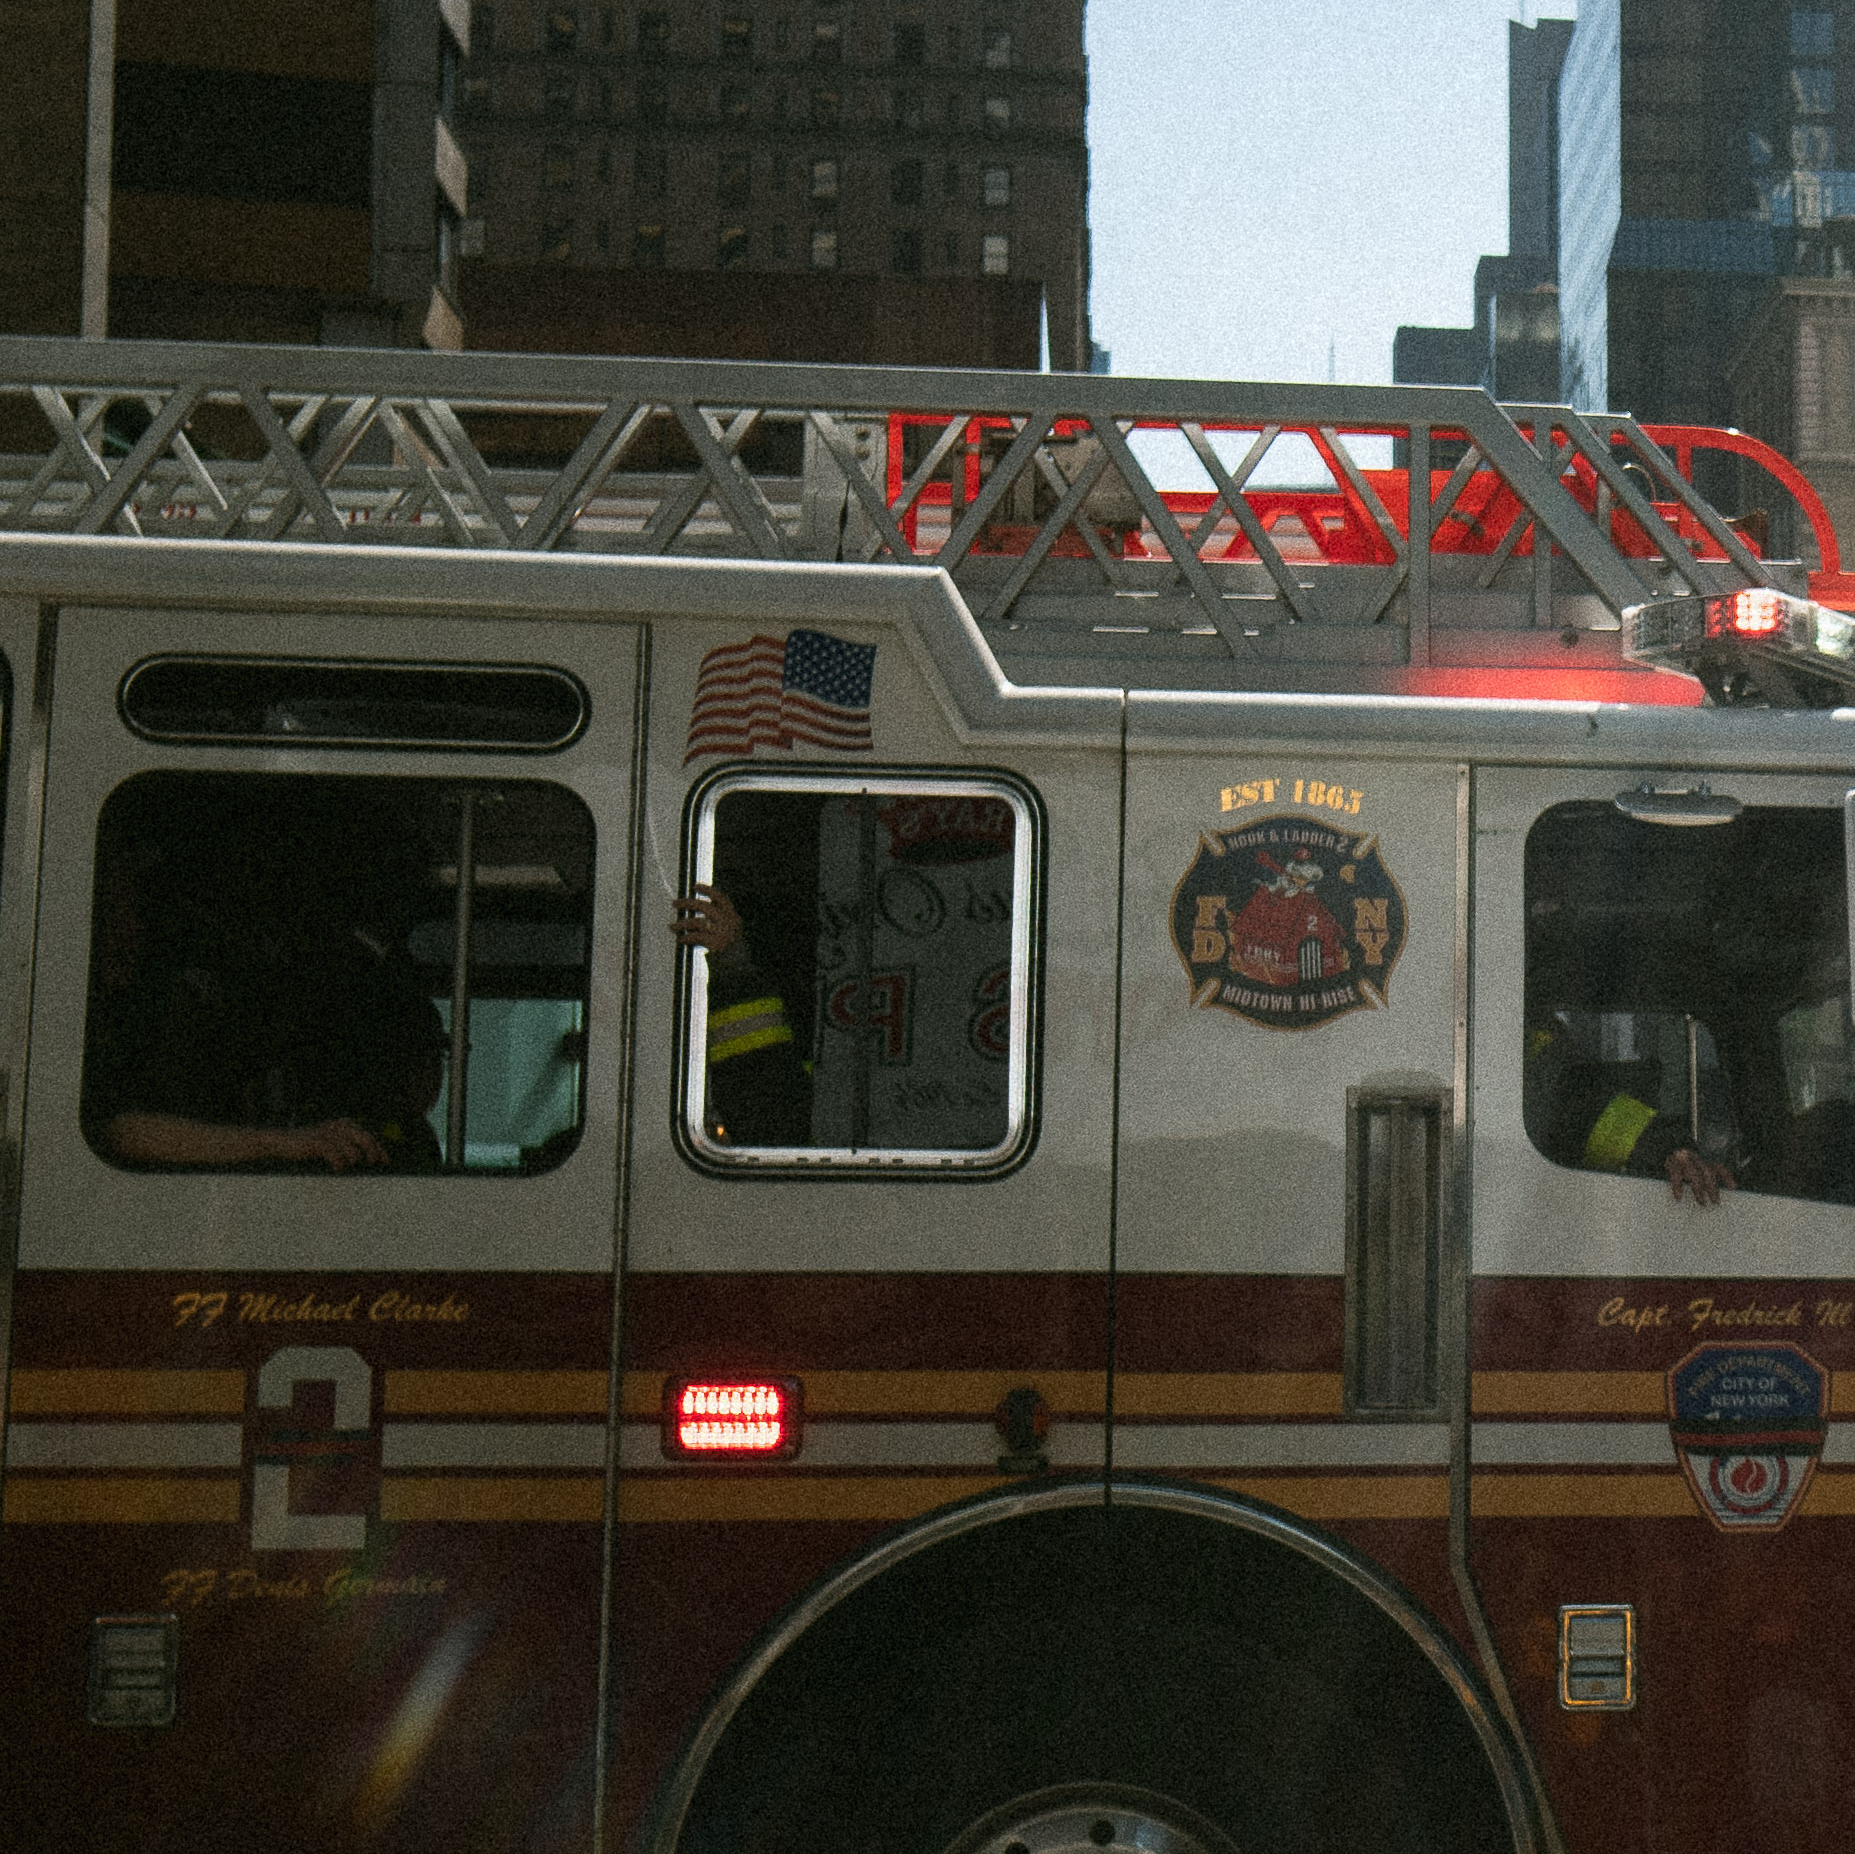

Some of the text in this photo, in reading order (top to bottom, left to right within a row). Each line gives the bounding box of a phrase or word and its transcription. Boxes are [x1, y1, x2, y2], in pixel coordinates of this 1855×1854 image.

[1219, 777, 1364, 815] EST 1865
[1227, 830, 1266, 854] HOOK
[1282, 828, 1336, 847] LADDER
[1336, 836, 1350, 854] 2
[1222, 983, 1294, 1011] MIDTOWN
[238, 1290, 361, 1325] Michael
[368, 1289, 470, 1325] Clarke
[1596, 1296, 1673, 1335] Capt.
[1717, 1354, 1812, 1395] DEPARTMENT
[1721, 1376, 1778, 1392] CITY OF
[1709, 1394, 1790, 1408] NEW YORK
[251, 1345, 373, 1551] 2
